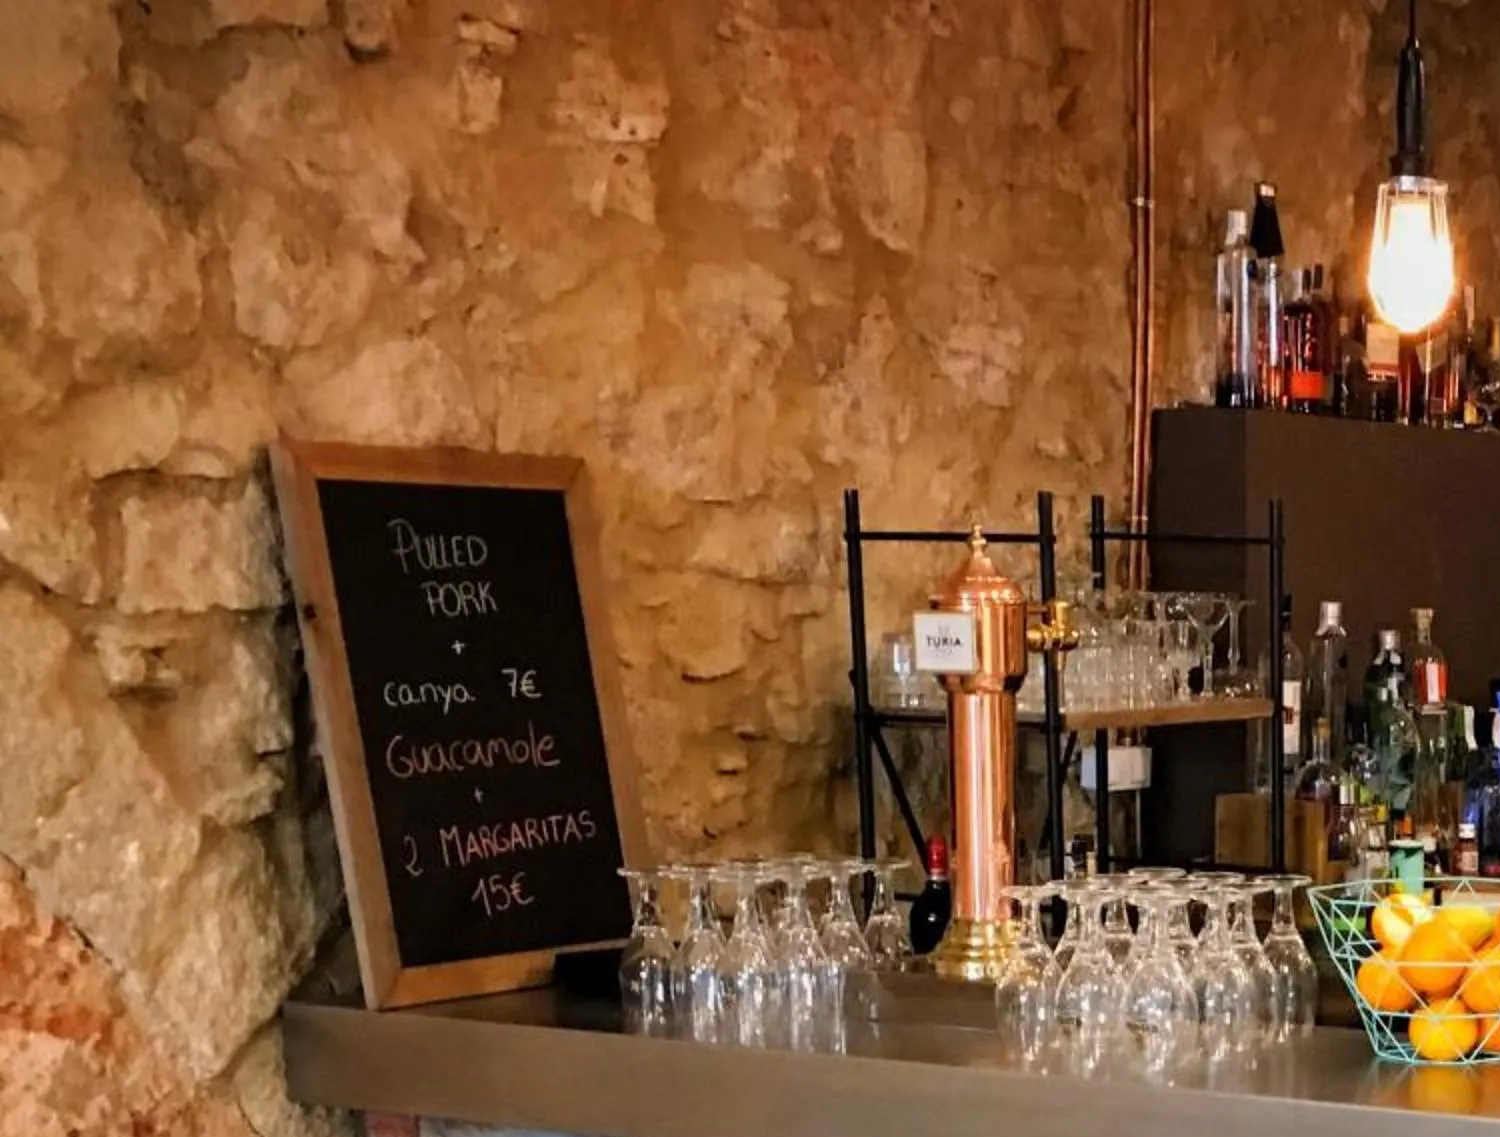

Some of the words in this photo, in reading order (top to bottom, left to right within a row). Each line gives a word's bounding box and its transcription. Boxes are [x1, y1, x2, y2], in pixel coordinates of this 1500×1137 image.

[387, 518, 488, 574] PULLED
[420, 581, 498, 617] PORK
[501, 668, 543, 698] 7€
[386, 719, 560, 778] Guacamole
[403, 835, 424, 876] 2
[439, 810, 596, 867] MARGARITAS
[471, 872, 535, 916] 15€
